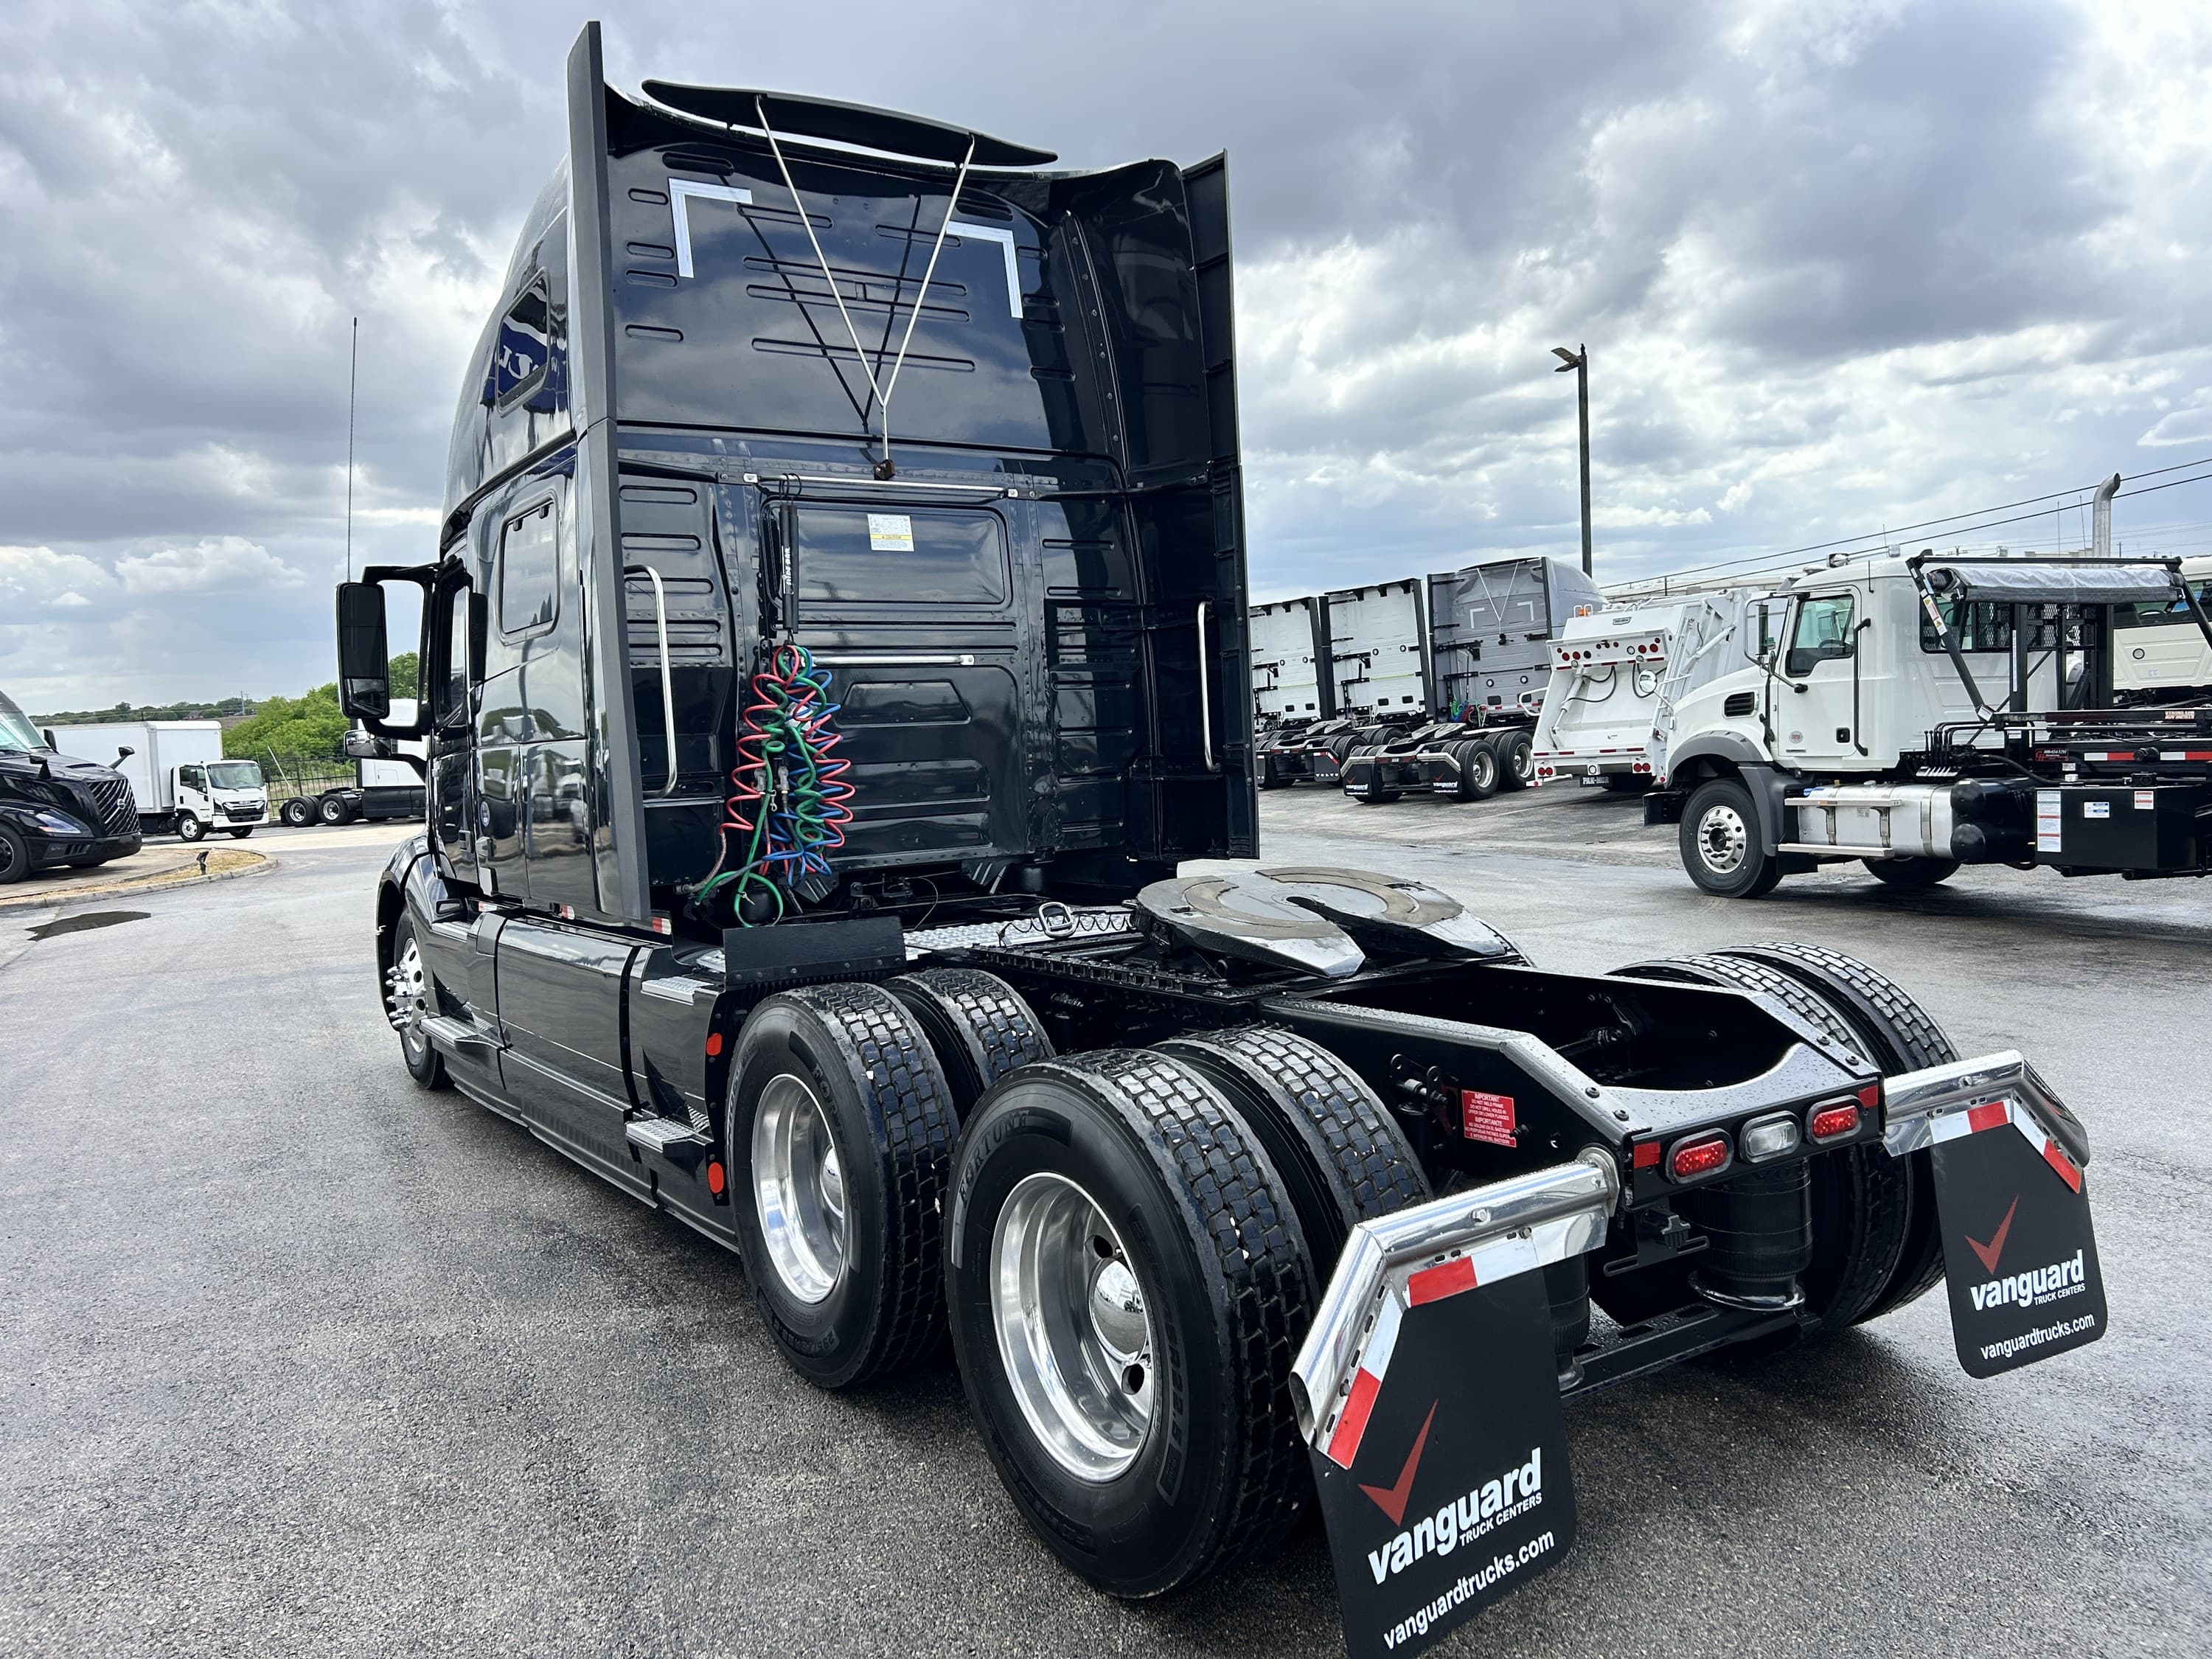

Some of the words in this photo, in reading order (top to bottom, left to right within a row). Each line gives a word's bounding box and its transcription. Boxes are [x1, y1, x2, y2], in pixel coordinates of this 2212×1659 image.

[1582, 776, 1609, 785] PAK-MOR
[1475, 1093, 1499, 1102] IMPORTANT
[1475, 1116, 1503, 1127] IMPORTANTE
[959, 1110, 1029, 1209] FORTUNE
[1970, 1249, 2084, 1311] vanguard
[2034, 1293, 2056, 1306] TRUCK
[2057, 1283, 2085, 1299] CENTERS
[1980, 1313, 2095, 1360] vanguardtrucks.com
[1368, 1447, 1541, 1585] vanguard
[1459, 1520, 1495, 1547] TRUCK
[1495, 1492, 1543, 1526] CENTERS
[1383, 1530, 1555, 1650] vanguardtrucks.com
